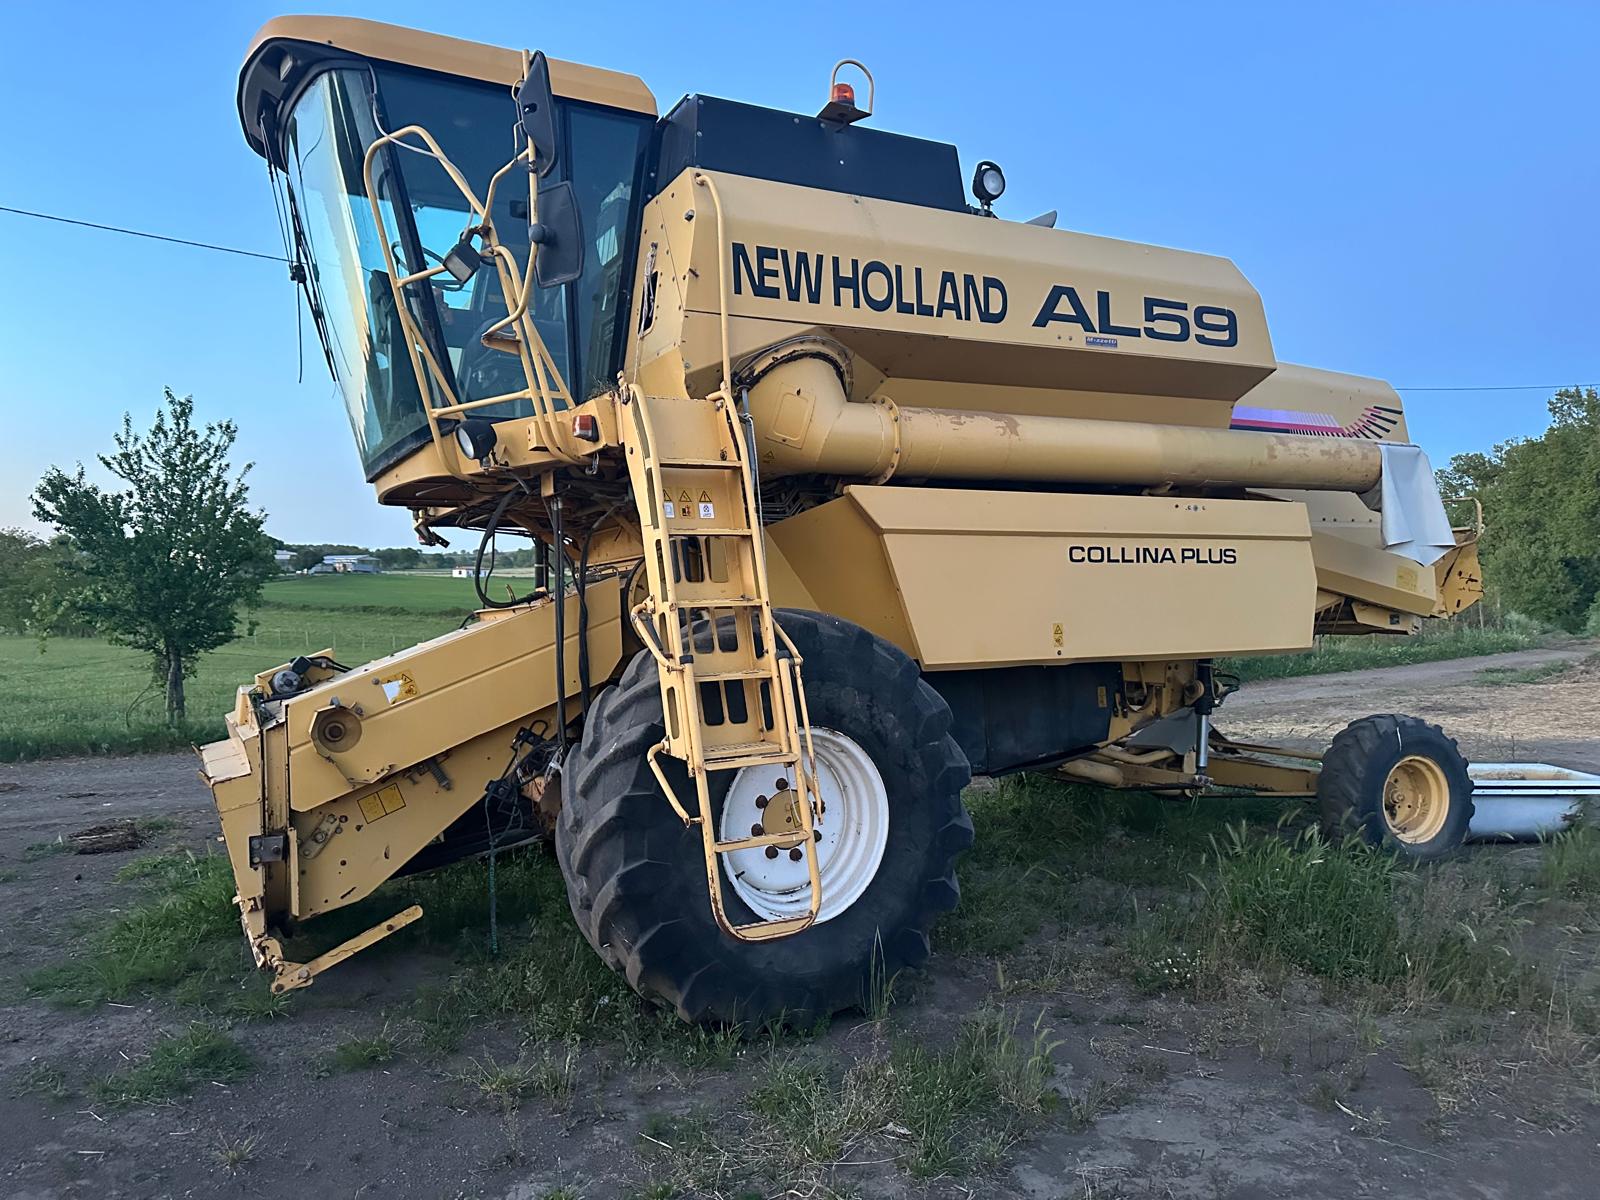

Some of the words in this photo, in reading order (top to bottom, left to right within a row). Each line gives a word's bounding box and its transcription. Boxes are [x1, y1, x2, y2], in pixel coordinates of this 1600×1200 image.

[732, 242, 823, 304] NEW
[832, 255, 1008, 324] HOLLAND
[1031, 285, 1238, 348] AL59
[1069, 545, 1177, 564] COLLINA
[1181, 547, 1237, 565] PLUS
